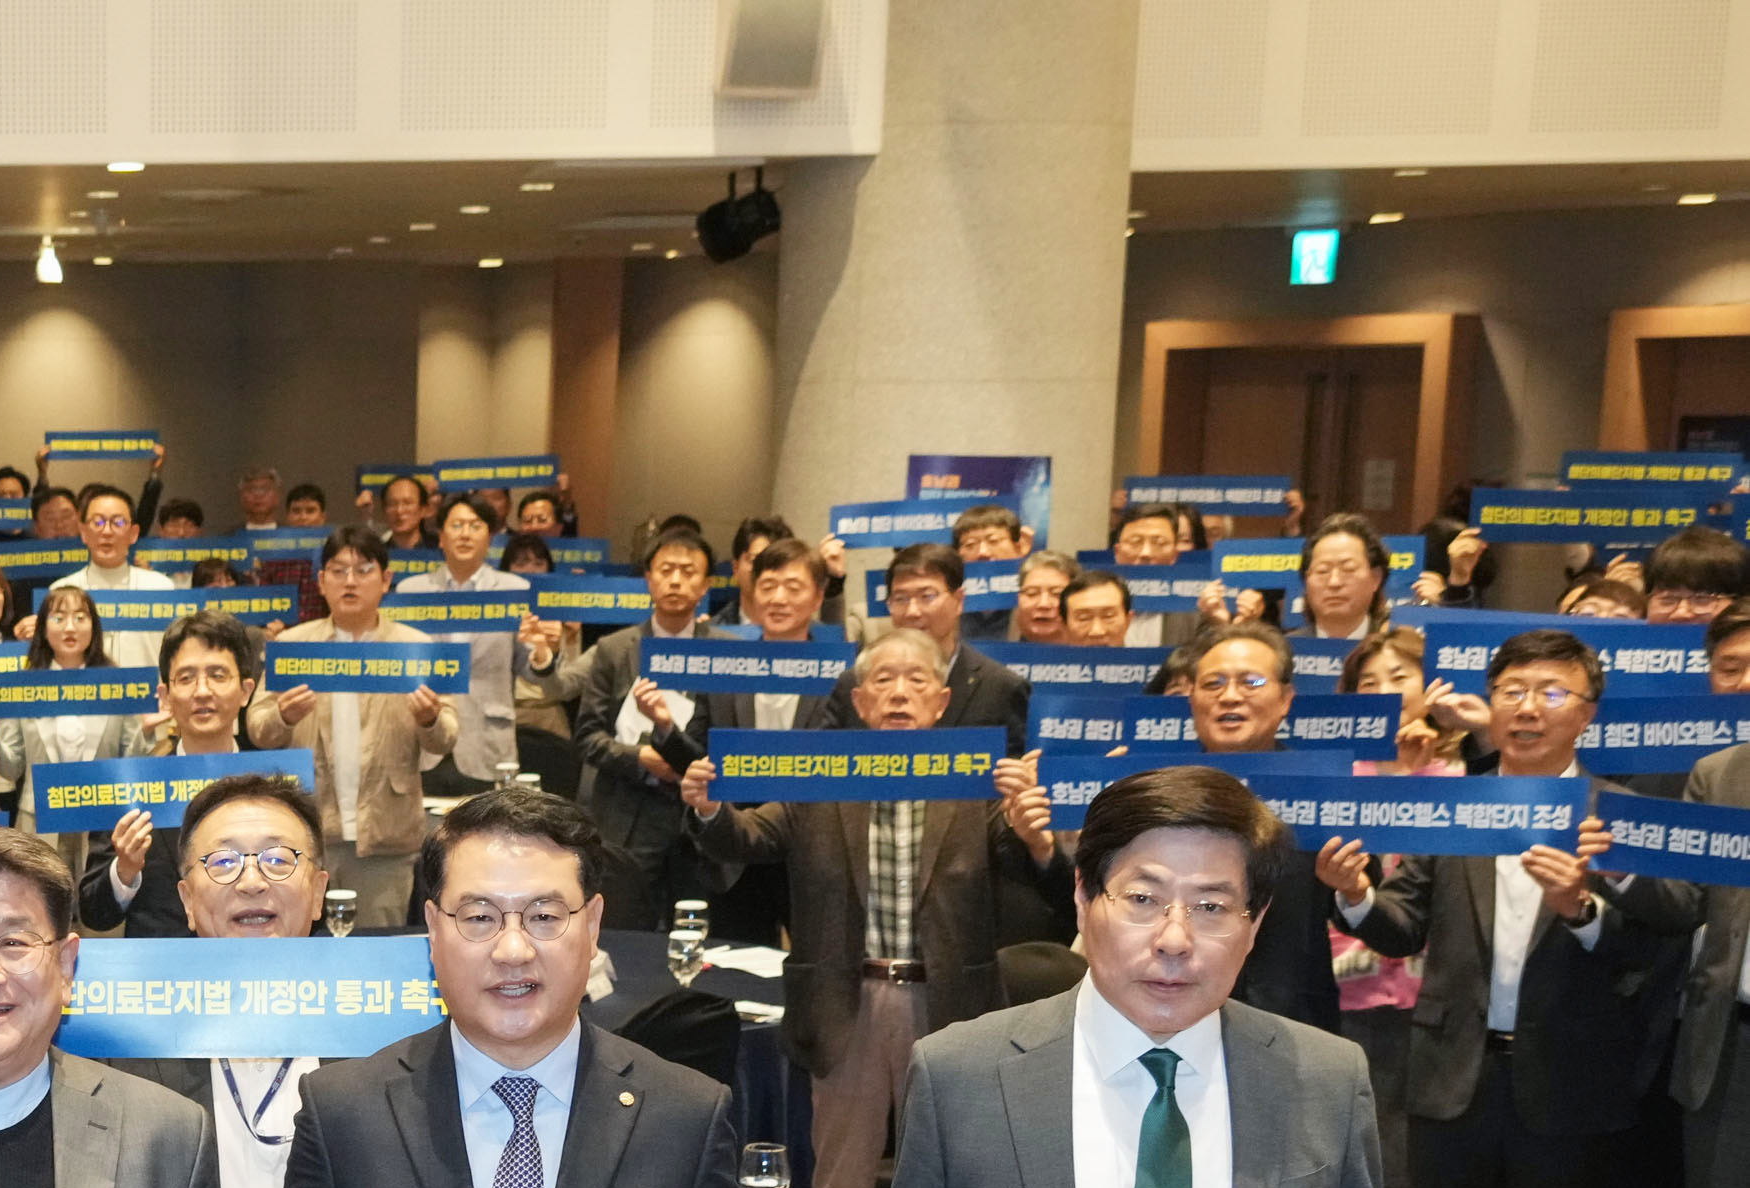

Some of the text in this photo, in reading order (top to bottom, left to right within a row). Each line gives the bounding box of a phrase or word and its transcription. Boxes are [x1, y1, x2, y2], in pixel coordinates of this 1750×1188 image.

[1436, 646, 1488, 670] 호남권
[1356, 717, 1387, 738] 조성
[1605, 723, 1641, 747] 첨단
[1644, 721, 1733, 745] 바이오헬스
[722, 753, 991, 778] 첨단의료단지법 개정안 통과 촉구
[47, 780, 165, 809] 첨단의료단지법
[1320, 802, 1357, 827] 첨단
[1360, 802, 1451, 828] 바이오헬스
[1455, 804, 1530, 829] 복합단지
[1532, 804, 1572, 831] 조성
[1669, 828, 1706, 855] 첨단
[61, 979, 231, 1015] 단의료단지법
[239, 979, 328, 1015] 개정안
[334, 979, 394, 1015] 통과
